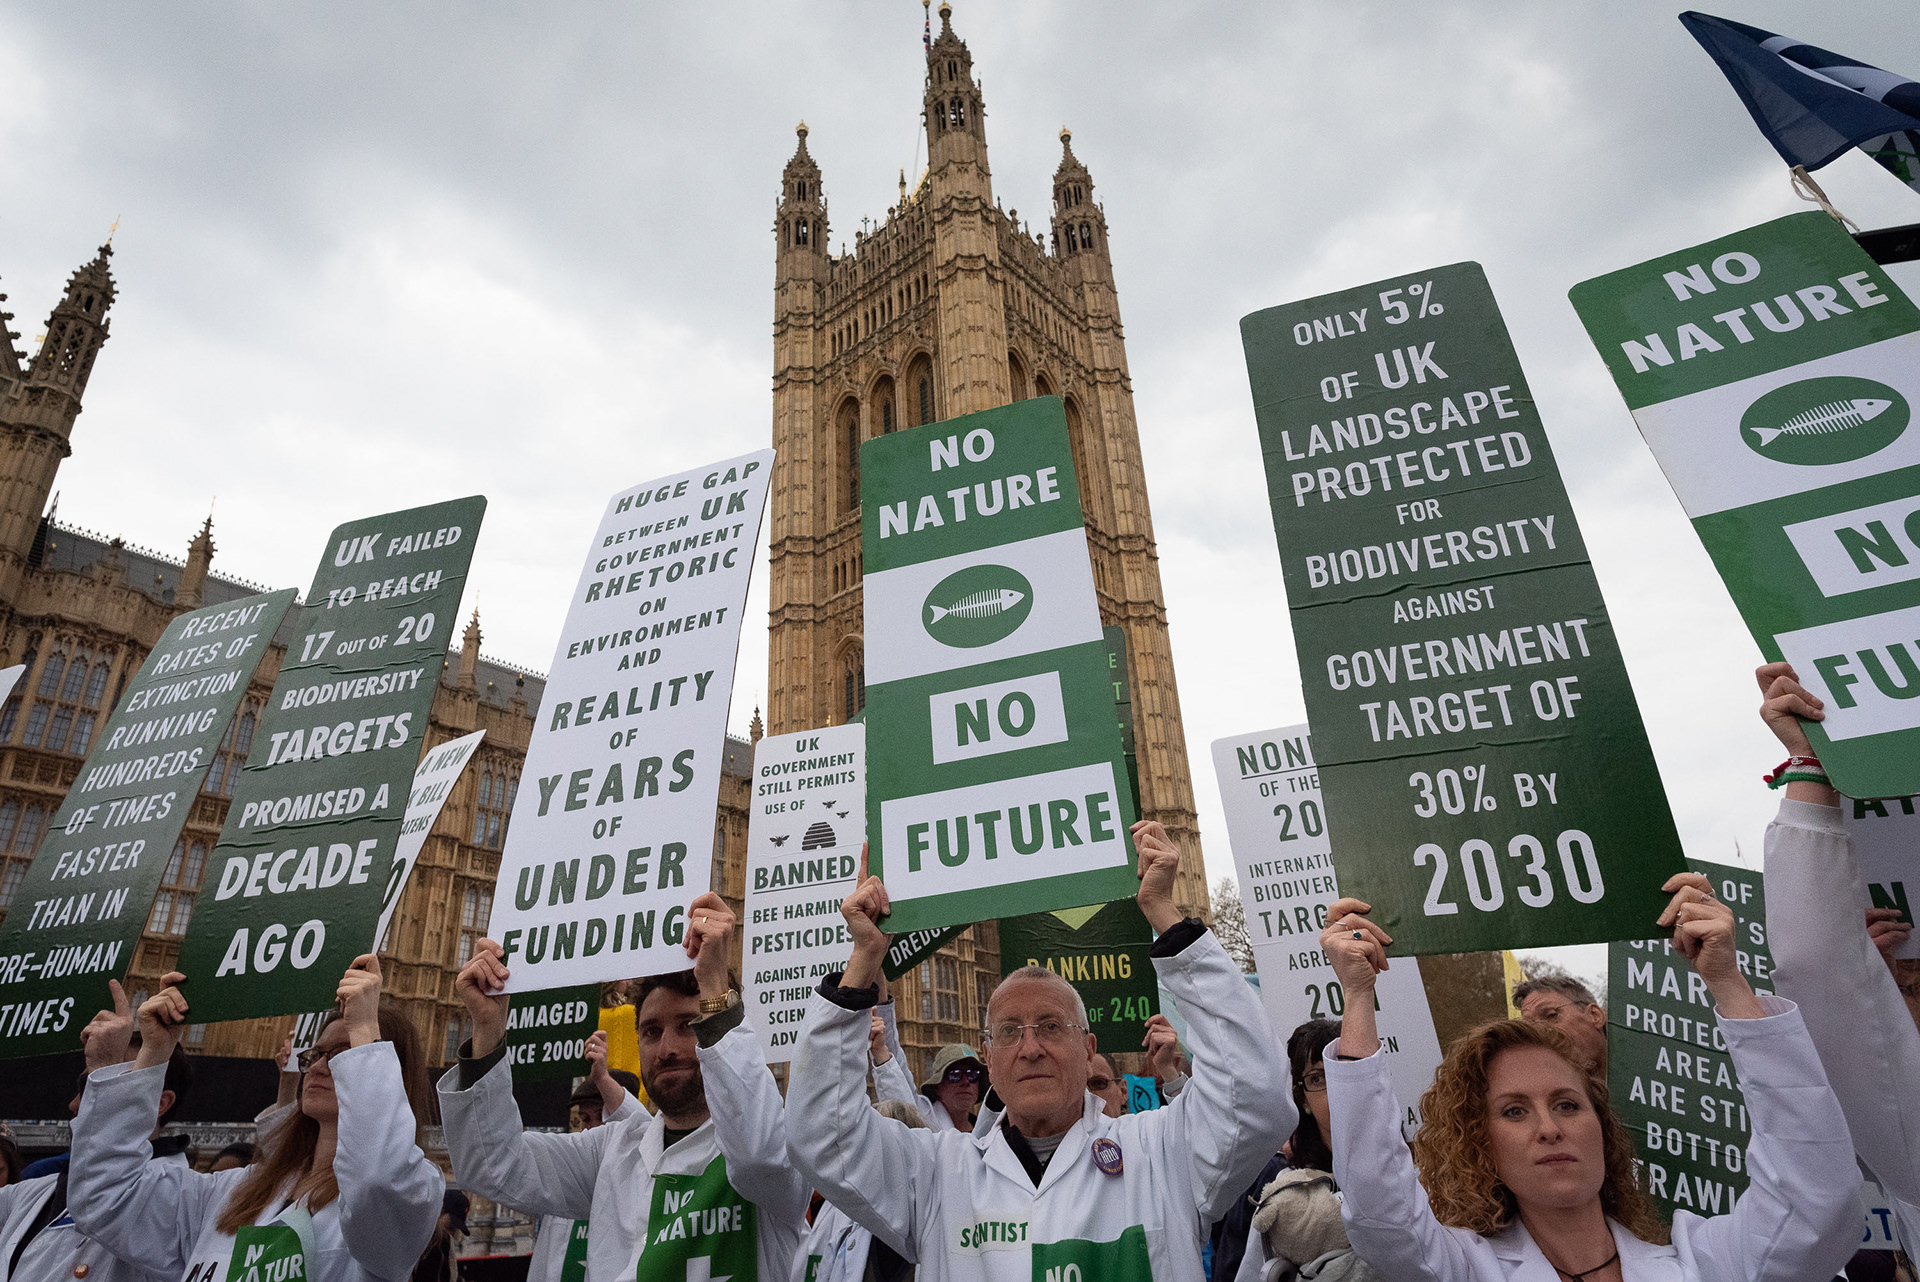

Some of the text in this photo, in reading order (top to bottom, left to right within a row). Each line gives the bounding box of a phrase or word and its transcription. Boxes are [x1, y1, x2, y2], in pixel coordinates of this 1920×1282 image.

[1663, 251, 1761, 302] NO
[1293, 281, 1444, 346] ONLY 5%
[1621, 271, 1889, 374] NATURE
[1320, 341, 1449, 402] OF UK
[1281, 385, 1519, 461] LANDSCAPE
[929, 428, 995, 472] NO
[1291, 431, 1531, 507] PROTECTED
[615, 461, 760, 514] HUGE GAP
[879, 466, 1061, 539] NATURE
[603, 489, 749, 547] BETWEEN UK
[1396, 498, 1442, 525] FOR
[334, 526, 462, 567] UK FAILED
[595, 523, 744, 573] GOVERNMENT
[1306, 515, 1556, 588] BIODIVERSITY
[327, 570, 442, 610] TO REACH
[585, 547, 738, 604] RHETORIC
[178, 603, 268, 640] RECENT
[639, 597, 667, 616] ON
[1394, 586, 1494, 623] AGAINST
[300, 613, 435, 662] 17 OUT OF 20
[567, 607, 728, 659] ENVIRONMENT
[1326, 618, 1591, 691] GOVERNMENT
[151, 634, 258, 676] RATES OF
[617, 647, 661, 672] AND
[1813, 640, 1920, 709] FU
[125, 670, 242, 713] EXTINCTION
[281, 668, 424, 710] BIODIVERSITY
[550, 670, 714, 732] REALITY
[1359, 676, 1582, 742] TARGET OF
[106, 708, 217, 751] RUNNING
[266, 712, 412, 767] TARGETS
[609, 728, 638, 750] OF
[954, 691, 1036, 746] NO
[416, 742, 473, 777] A NEW
[761, 752, 855, 778] GOVERNMENT
[796, 737, 820, 753] UK
[1236, 735, 1316, 775] NON
[81, 747, 203, 793] HUNDREDS
[537, 749, 695, 817] YEARS
[758, 770, 856, 797] STILL PERMITS
[1259, 774, 1320, 797] OF THE
[1409, 764, 1558, 818] 30% BY
[65, 792, 176, 835] OF TIMES
[238, 787, 365, 828] PROMISED
[370, 783, 389, 811] A
[416, 780, 449, 807] BILL
[765, 799, 805, 815] USE OF
[592, 815, 623, 840] OF
[906, 791, 1116, 872] FUTURE
[1273, 799, 1323, 842] 20
[50, 839, 145, 881] FASTER
[215, 839, 378, 901] DECADE
[514, 841, 687, 911] UNDER
[754, 855, 856, 890] BANNED
[1413, 829, 1604, 916] 2030
[27, 887, 130, 931] THAN IN
[1253, 875, 1336, 902] BIODIVER
[1722, 880, 1753, 904] OF
[752, 898, 844, 924] BEE HARMIN
[1259, 903, 1328, 938] TARG
[215, 919, 326, 978] AGO
[502, 905, 684, 967] FUNDING
[0, 940, 123, 985] PRE-HUMAN
[754, 960, 850, 984] AGAINST ADVIC
[1289, 950, 1331, 970] AGRE
[759, 986, 812, 1004] OF THEIR
[1628, 957, 1709, 1008] MAR
[0, 997, 75, 1038] TIMES
[506, 1001, 588, 1030] AMAGED
[768, 1008, 806, 1025] SCIEN
[1090, 996, 1150, 1022] OF 240
[1626, 1004, 1727, 1050] PROTEC
[507, 1038, 585, 1065] NCE 2000
[770, 1030, 798, 1047] ADV
[1656, 1047, 1743, 1093] AREA
[1629, 1076, 1746, 1132] ARE STI
[1647, 1121, 1742, 1173] BOTTO
[663, 1189, 694, 1215] NO
[653, 1205, 742, 1246] NATURE
